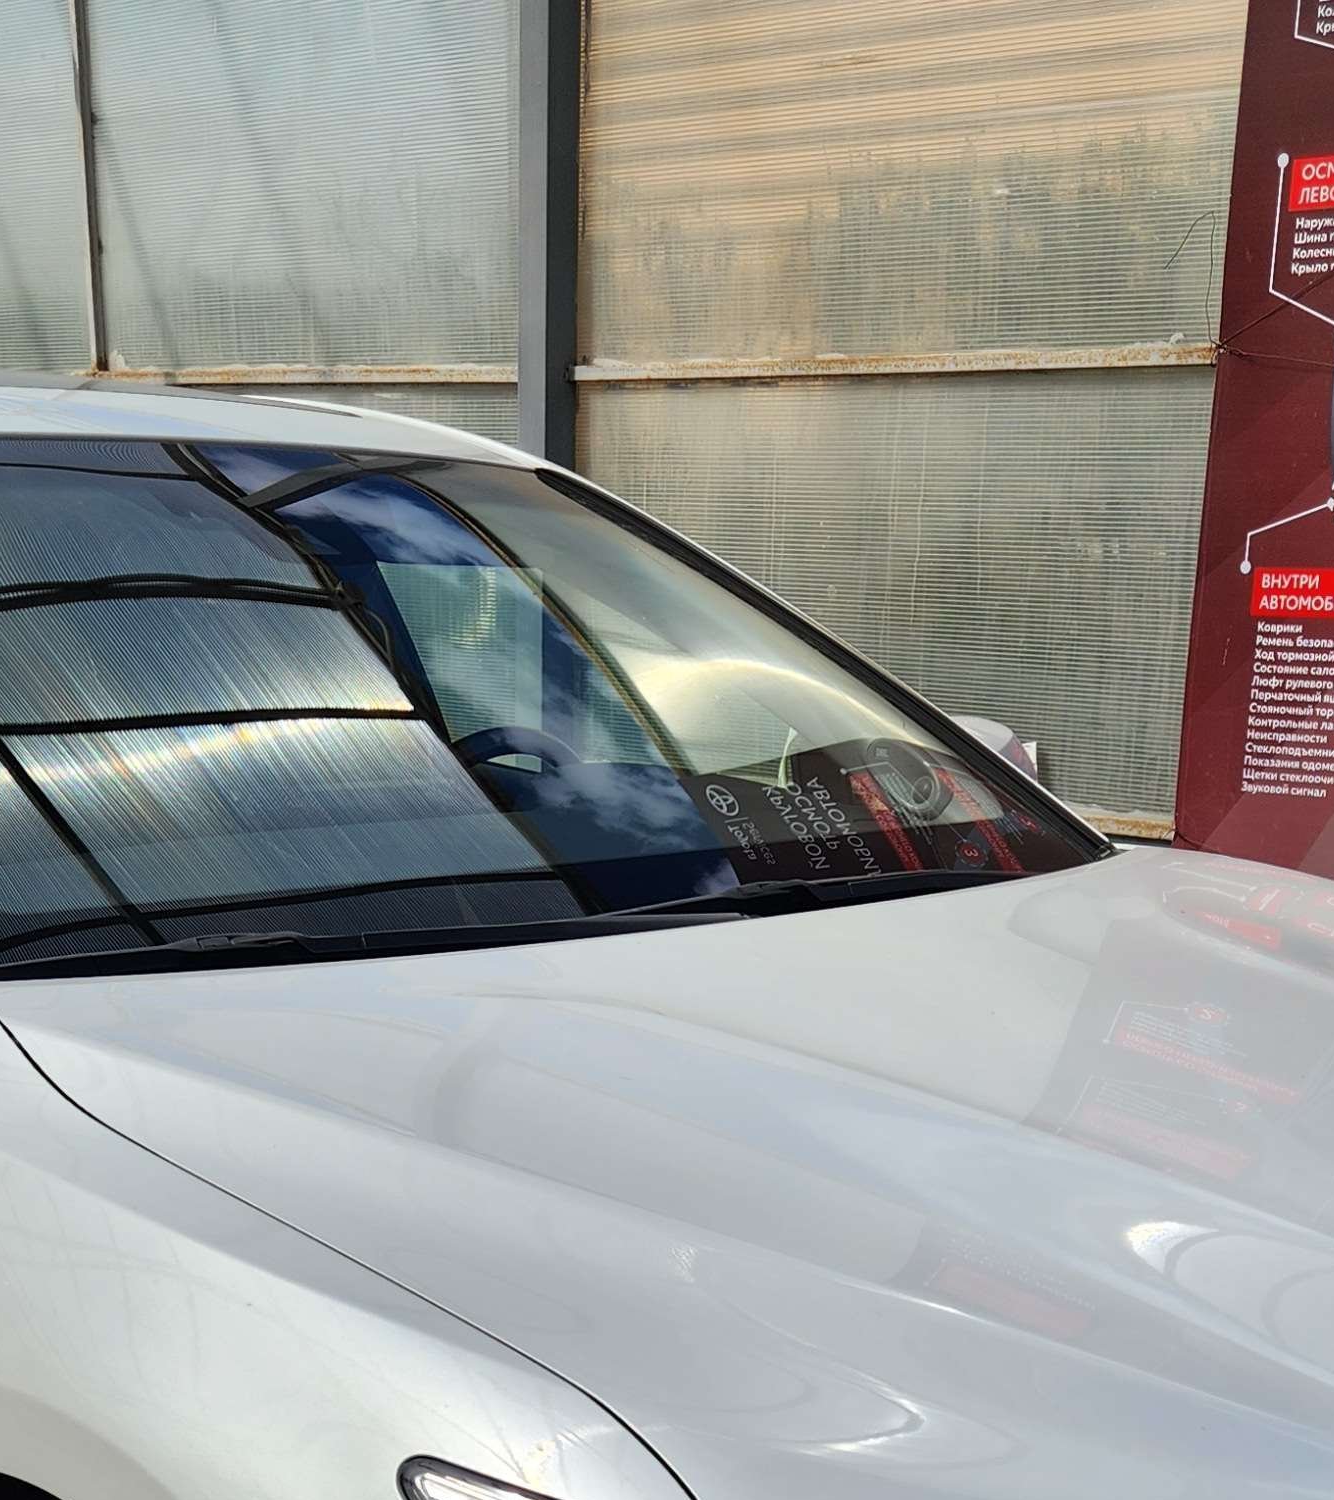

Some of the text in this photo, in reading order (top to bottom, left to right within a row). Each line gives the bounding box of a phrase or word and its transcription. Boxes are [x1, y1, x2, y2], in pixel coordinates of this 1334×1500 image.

[1294, 232, 1327, 244] Шина
[1291, 262, 1328, 276] Крыло
[1261, 573, 1320, 589] ВНУТРИ
[1257, 621, 1303, 634] Коврики
[1256, 635, 1294, 647] Ремень
[1254, 649, 1275, 661] Ход
[1277, 651, 1334, 664] тормозной
[1253, 663, 1308, 674] Состояние
[1251, 676, 1284, 689] Люфт
[1285, 680, 1333, 690] рулевого
[1250, 689, 1322, 703] Перчаточный
[1249, 702, 1313, 716] Стояночный
[1248, 716, 1319, 729] Контрольные
[1247, 729, 1328, 743] Неисправности
[1244, 755, 1299, 769] Показания
[1242, 768, 1278, 781] Щетки
[1241, 781, 1327, 797] Звуковой сигнал
